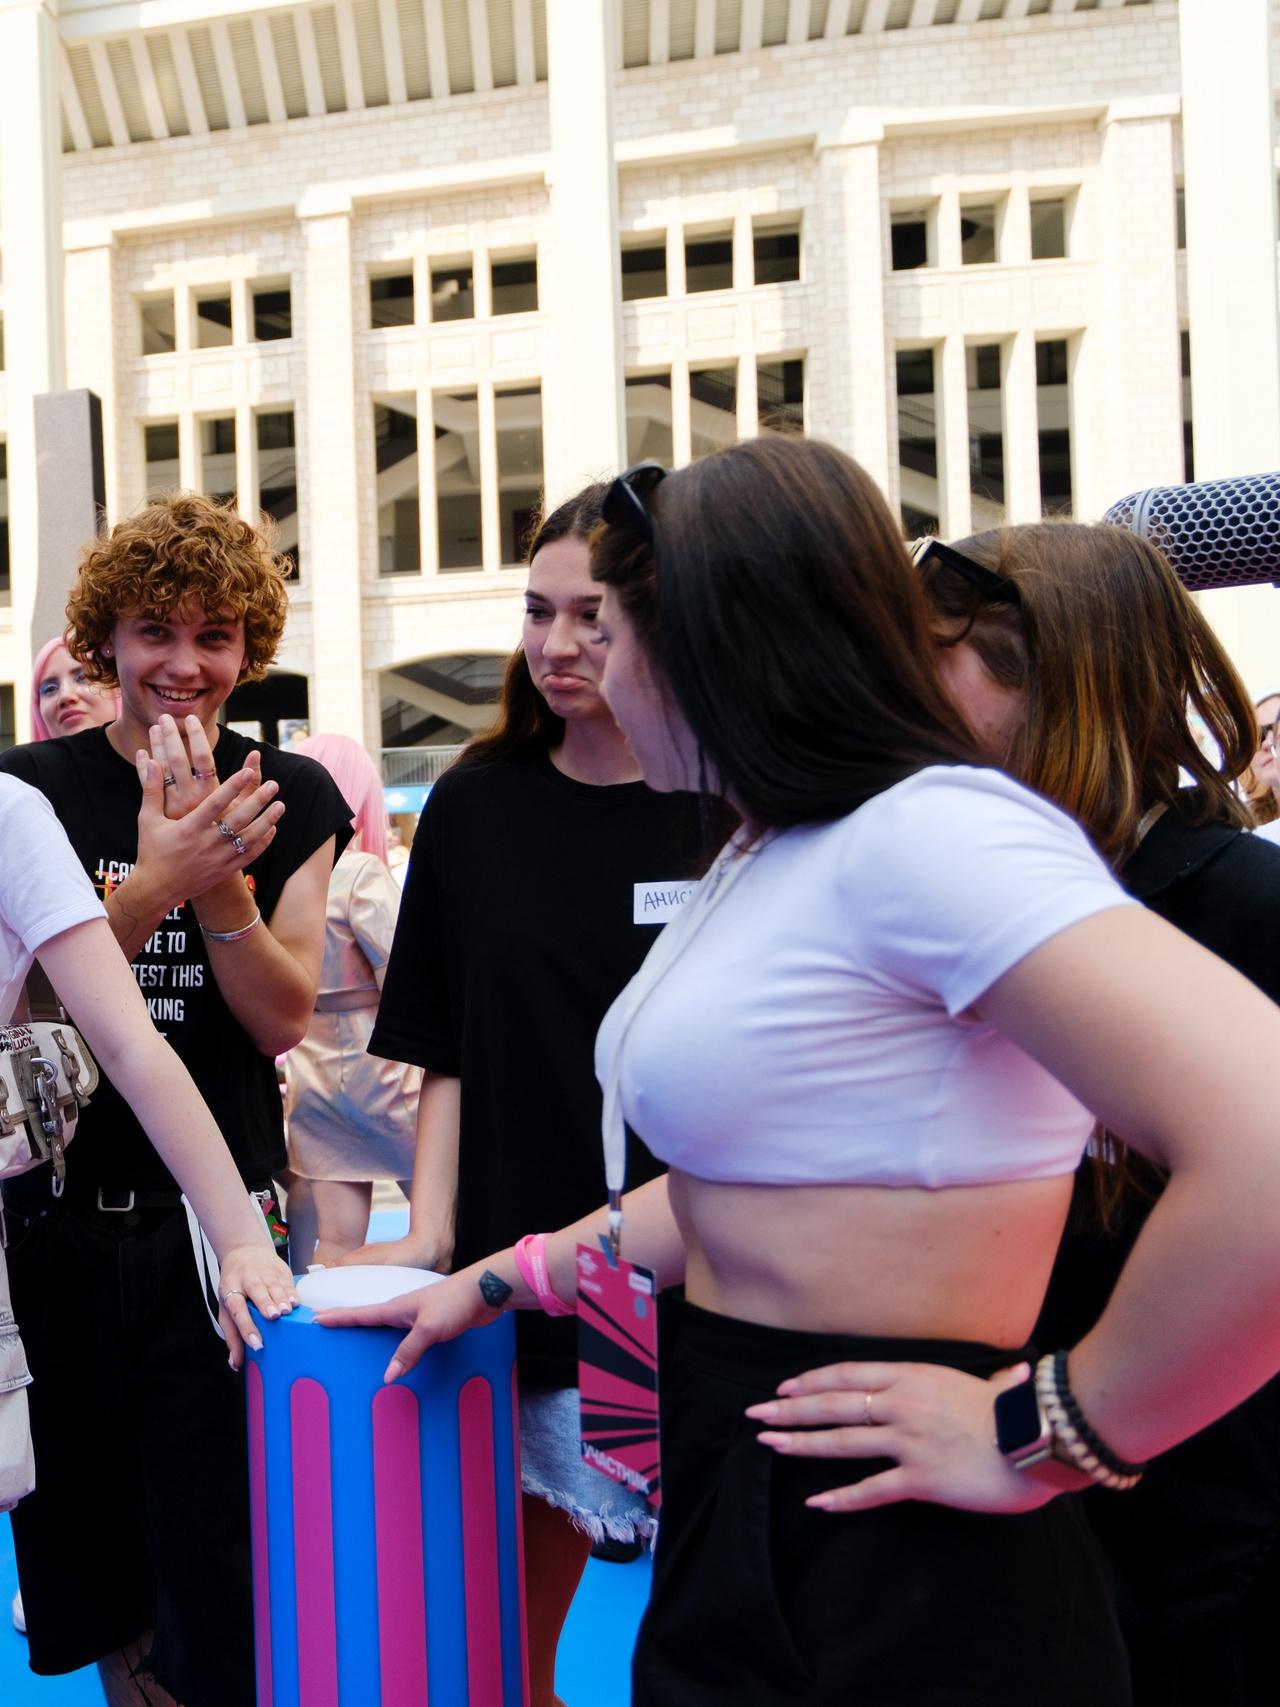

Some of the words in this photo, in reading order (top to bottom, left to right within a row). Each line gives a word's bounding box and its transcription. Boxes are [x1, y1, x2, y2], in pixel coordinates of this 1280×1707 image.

[644, 890, 693, 912] АНИС
[166, 931, 186, 953] TO
[130, 963, 167, 987] TEST
[171, 964, 204, 987] THIS
[147, 998, 185, 1021] KING
